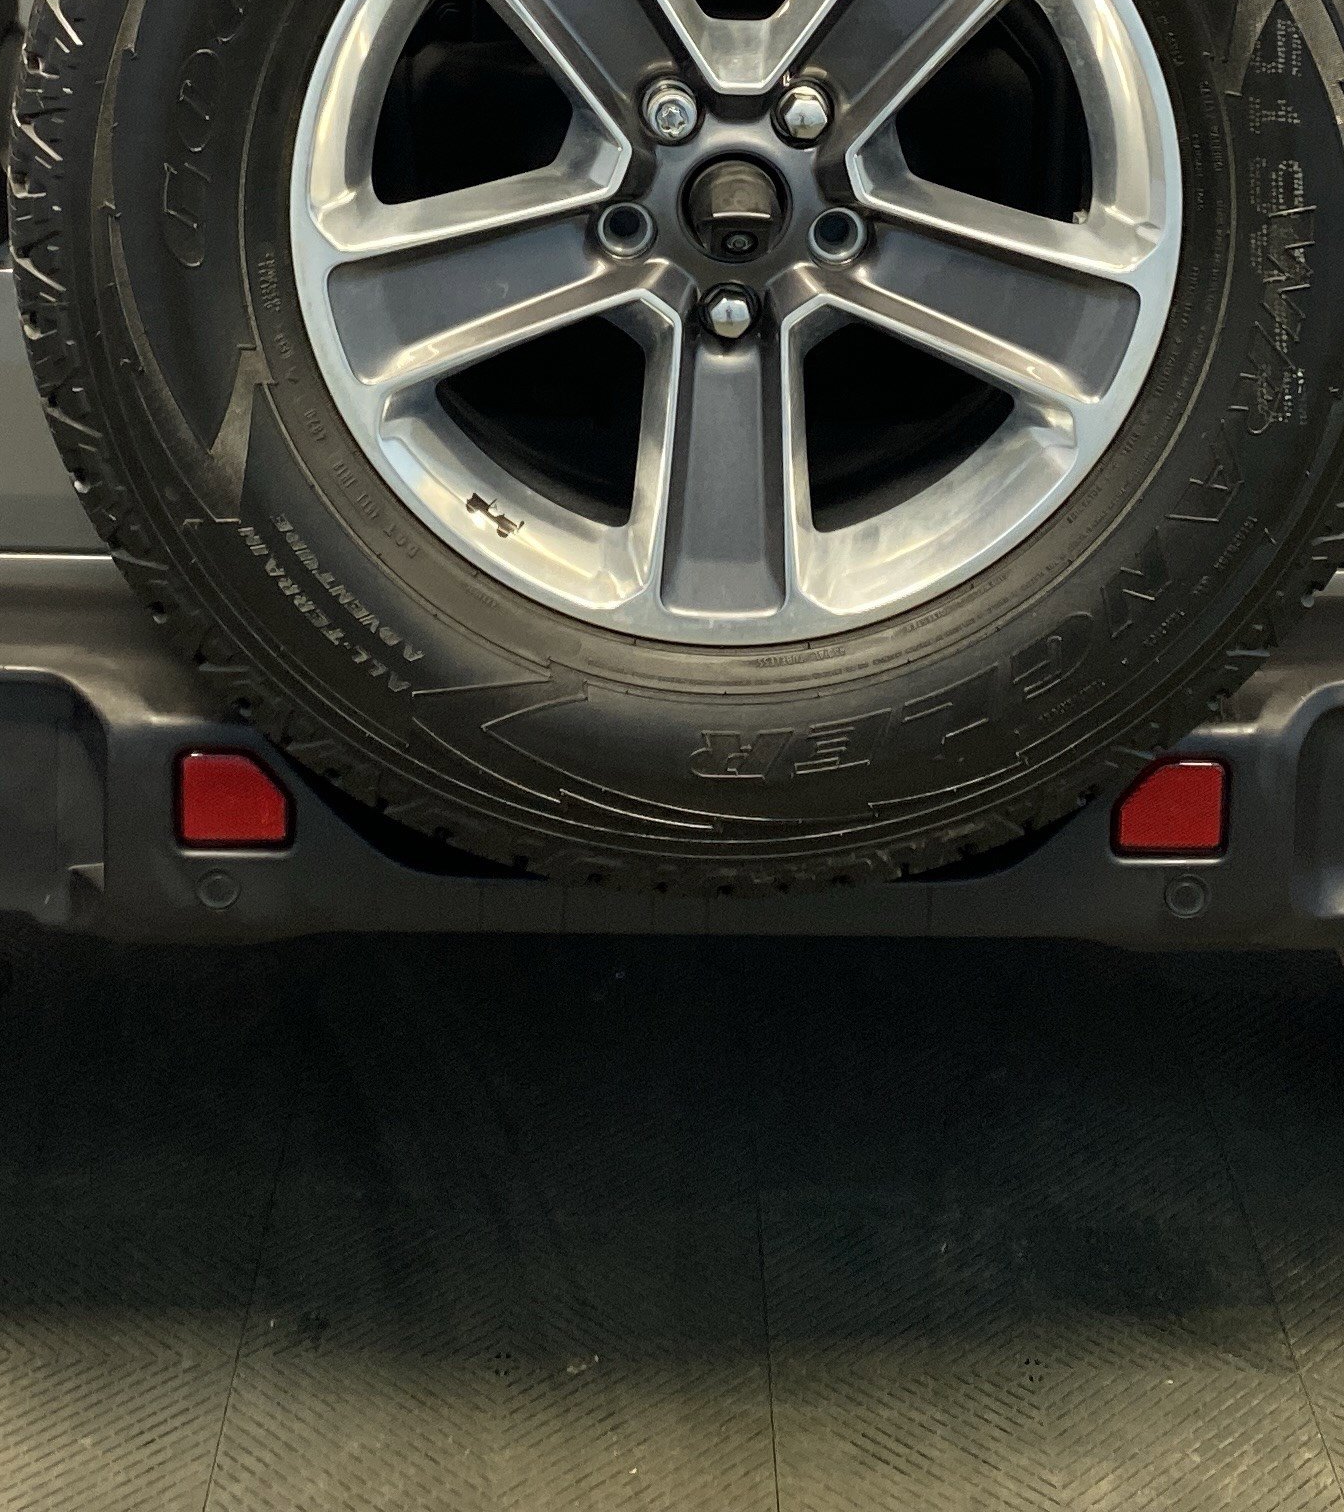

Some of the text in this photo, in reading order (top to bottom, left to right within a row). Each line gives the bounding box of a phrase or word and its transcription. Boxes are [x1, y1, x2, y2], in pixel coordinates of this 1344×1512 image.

[687, 205, 1318, 778] WRANGLER
[235, 523, 411, 694] ALL-TERRAIN
[269, 512, 425, 663] ADVENTURE
